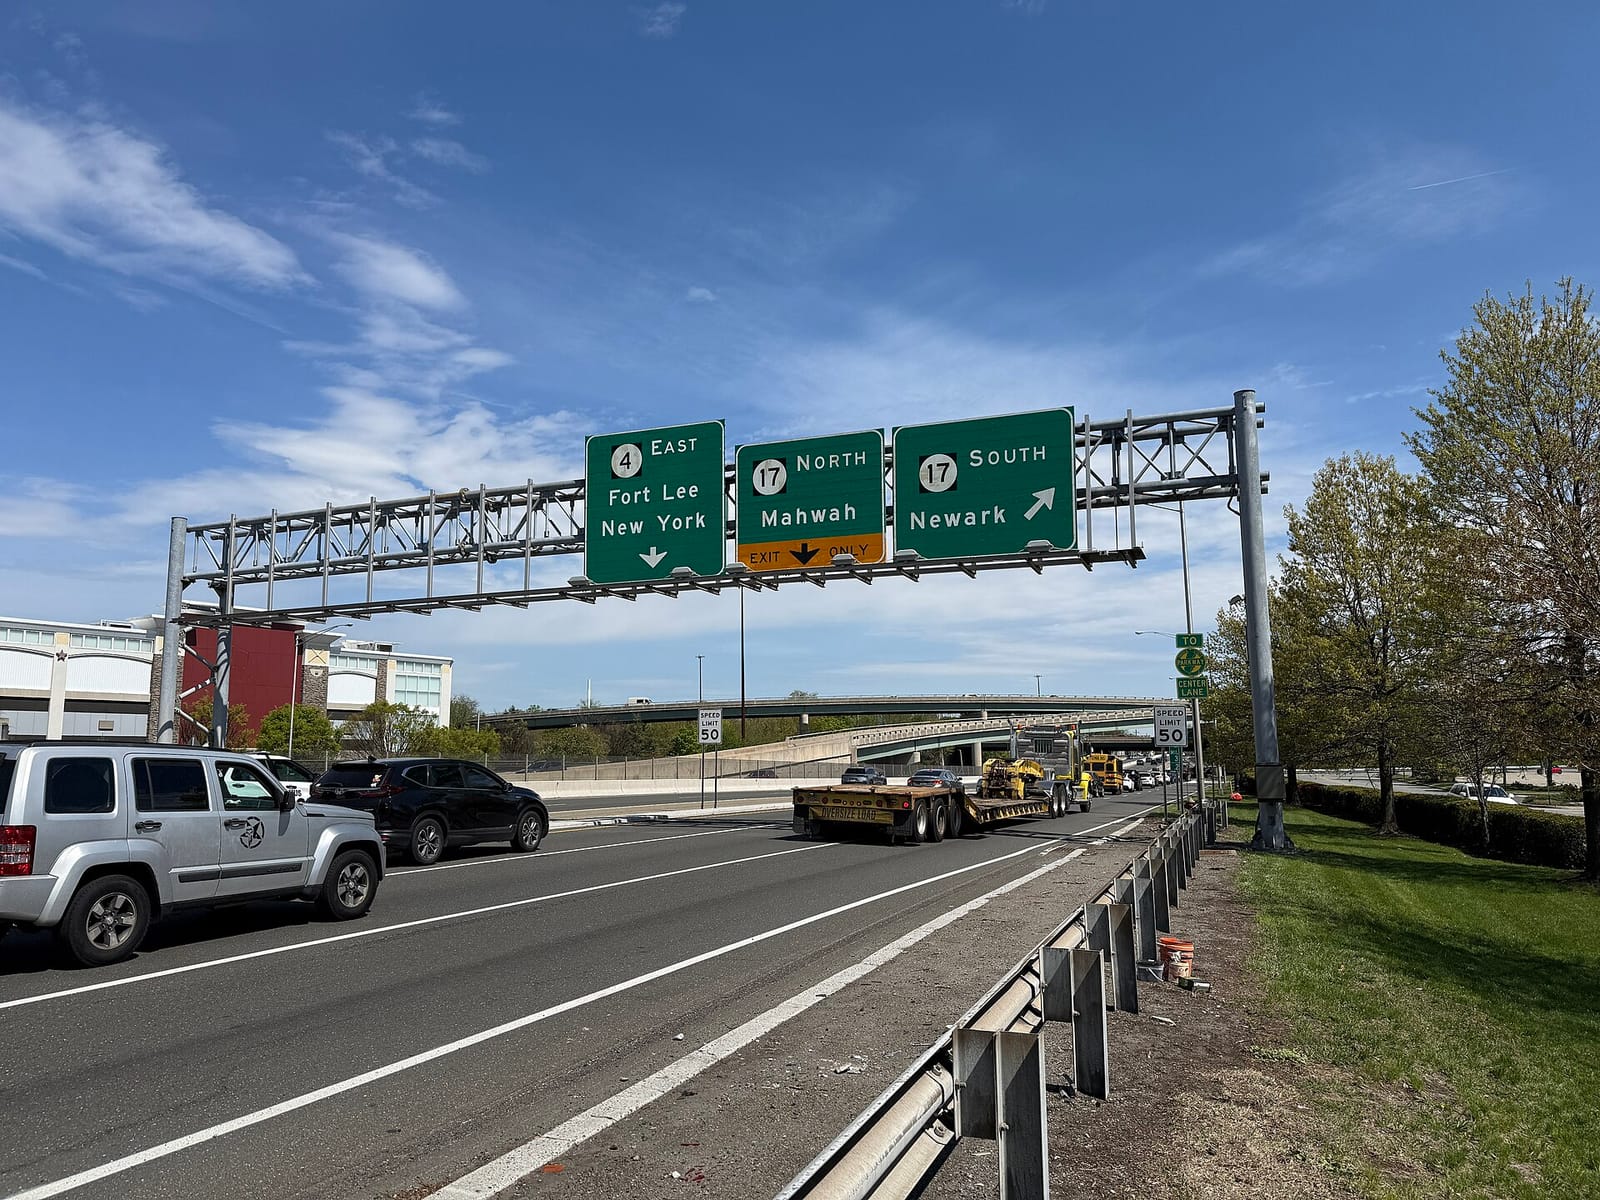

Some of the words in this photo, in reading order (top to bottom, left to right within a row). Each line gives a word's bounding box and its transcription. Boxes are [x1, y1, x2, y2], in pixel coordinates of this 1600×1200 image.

[619, 452, 631, 470] 4
[651, 438, 697, 456] EAST
[928, 463, 950, 484] 17
[969, 446, 1046, 467] SOUTH
[760, 467, 780, 487] 17
[797, 451, 865, 472] NORTH
[610, 486, 650, 506] Fort
[663, 484, 698, 501] Lee
[602, 519, 644, 536] New
[657, 512, 706, 531] York
[762, 503, 856, 527] Mahwah
[910, 506, 1006, 530] Newark
[750, 551, 780, 564] EXIT
[1183, 637, 1197, 645] TO
[1178, 680, 1206, 688] CENTER
[702, 729, 719, 740] 50
[1159, 729, 1183, 742] 50
[821, 807, 856, 819] OVERSIZE
[857, 810, 876, 820] LOAD
